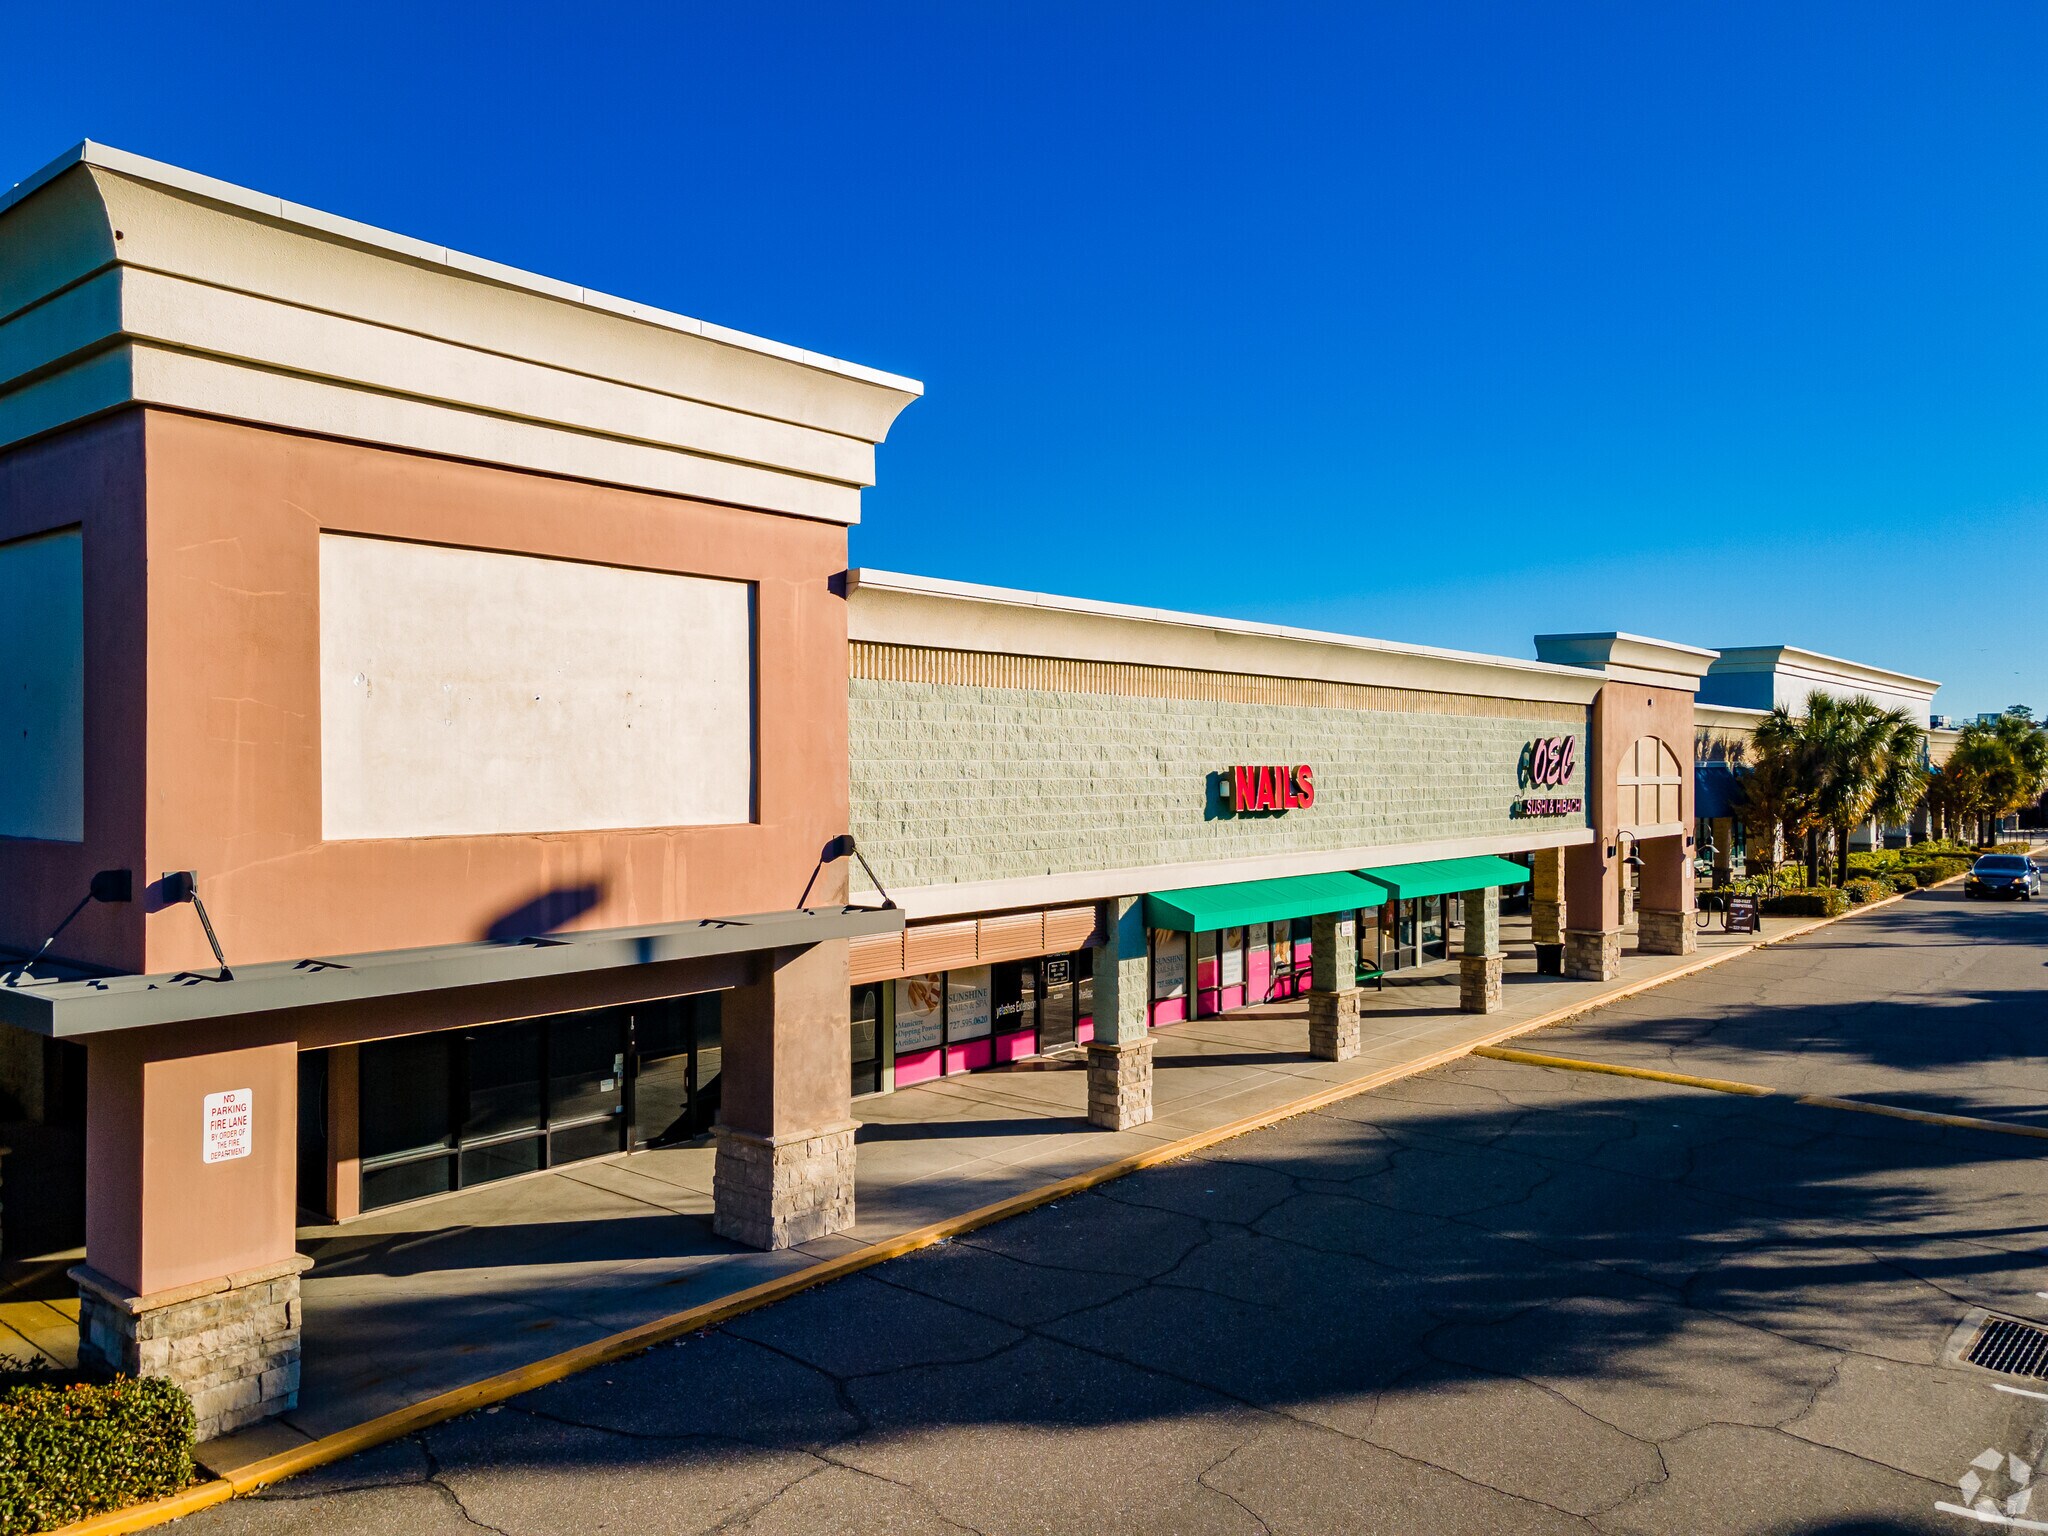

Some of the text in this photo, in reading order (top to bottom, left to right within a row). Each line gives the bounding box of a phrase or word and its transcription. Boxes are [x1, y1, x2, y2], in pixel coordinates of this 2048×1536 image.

[1234, 764, 1315, 812] NAILS
[1526, 798, 1582, 815] SUSHI & HIBACHI
[948, 988, 988, 1003] SUNSHINE
[948, 1002, 970, 1013] NAILS
[969, 1001, 974, 1009] &
[975, 999, 988, 1009] SPA
[898, 1019, 924, 1028] Manicure
[949, 1015, 988, 1030] 727.595.0620
[897, 1033, 937, 1047] Artificial Nails
[898, 1028, 921, 1038] Dipping
[223, 1094, 236, 1104] NO
[211, 1103, 247, 1117] PARKING
[210, 1115, 248, 1131] FIRE LANE
[211, 1128, 246, 1141] BY ORDER OF
[217, 1138, 240, 1149] THE FIRE
[210, 1146, 246, 1160] DEPARTMENT
